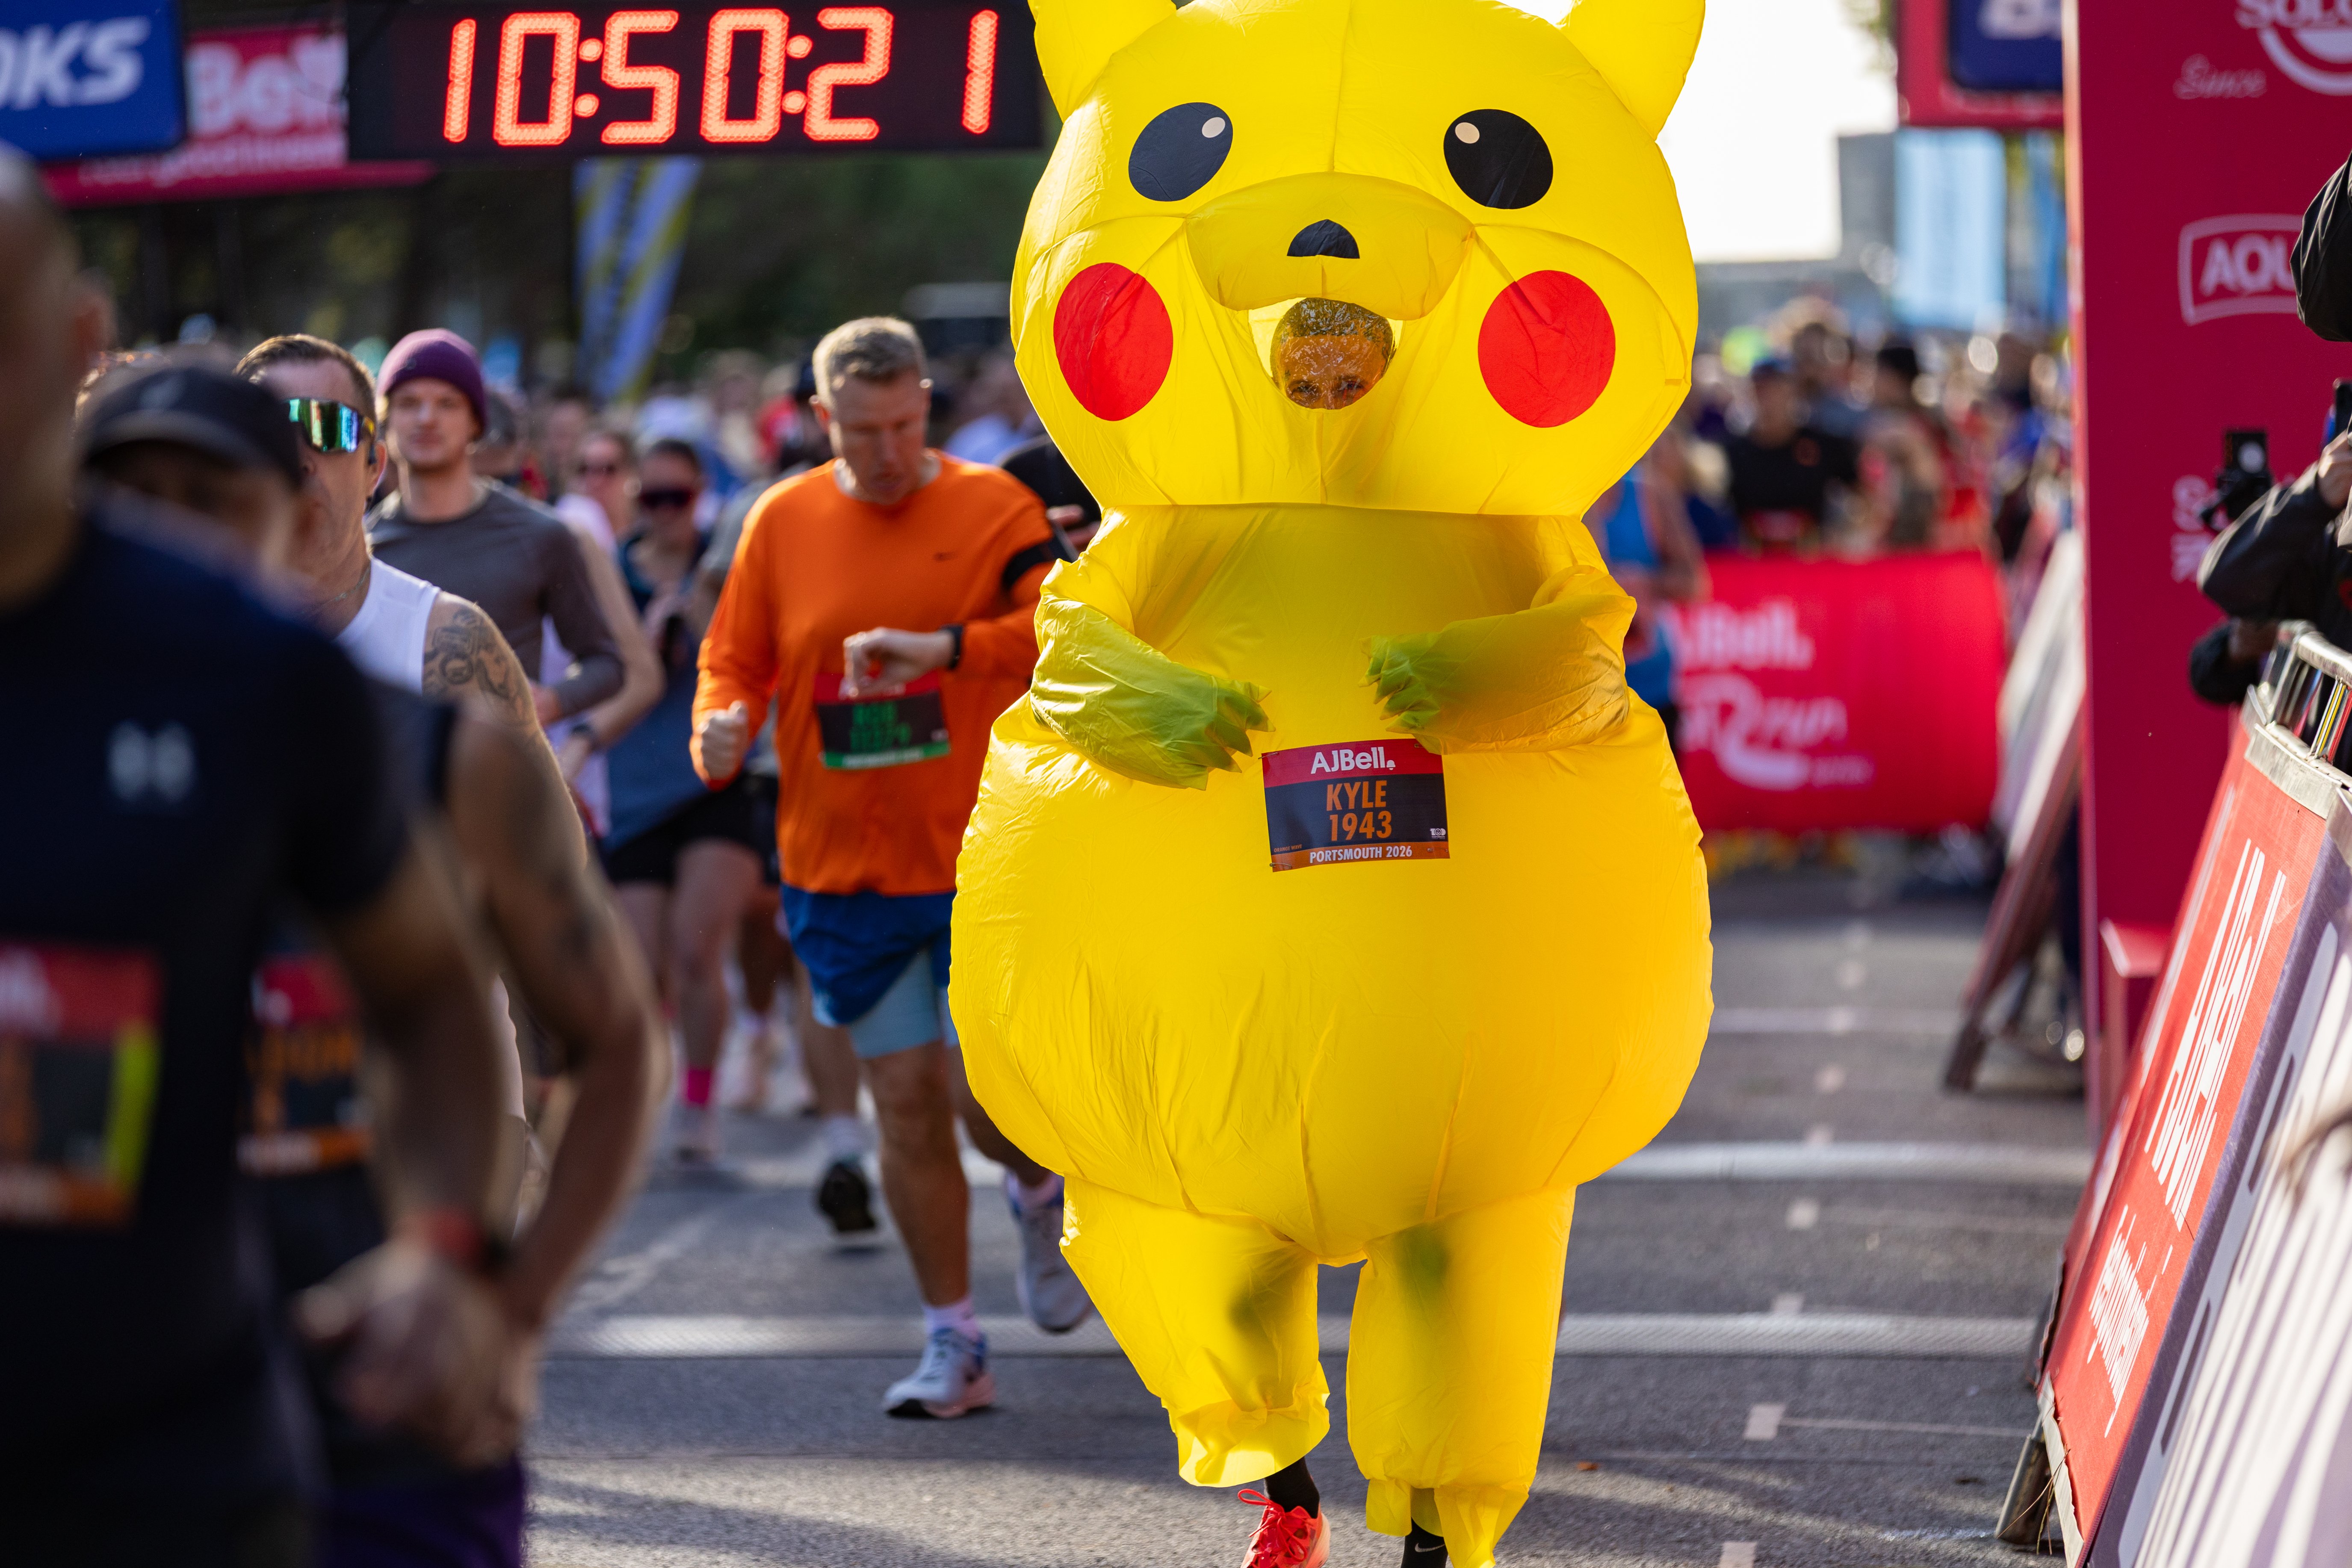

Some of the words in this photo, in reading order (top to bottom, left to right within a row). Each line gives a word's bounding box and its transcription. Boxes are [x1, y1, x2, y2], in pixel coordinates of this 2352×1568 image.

[1327, 780, 1388, 811] KYLE
[1329, 811, 1392, 842] 1943
[1310, 847, 1383, 864] PORTSMOUTH
[1386, 845, 1413, 858] 2026
